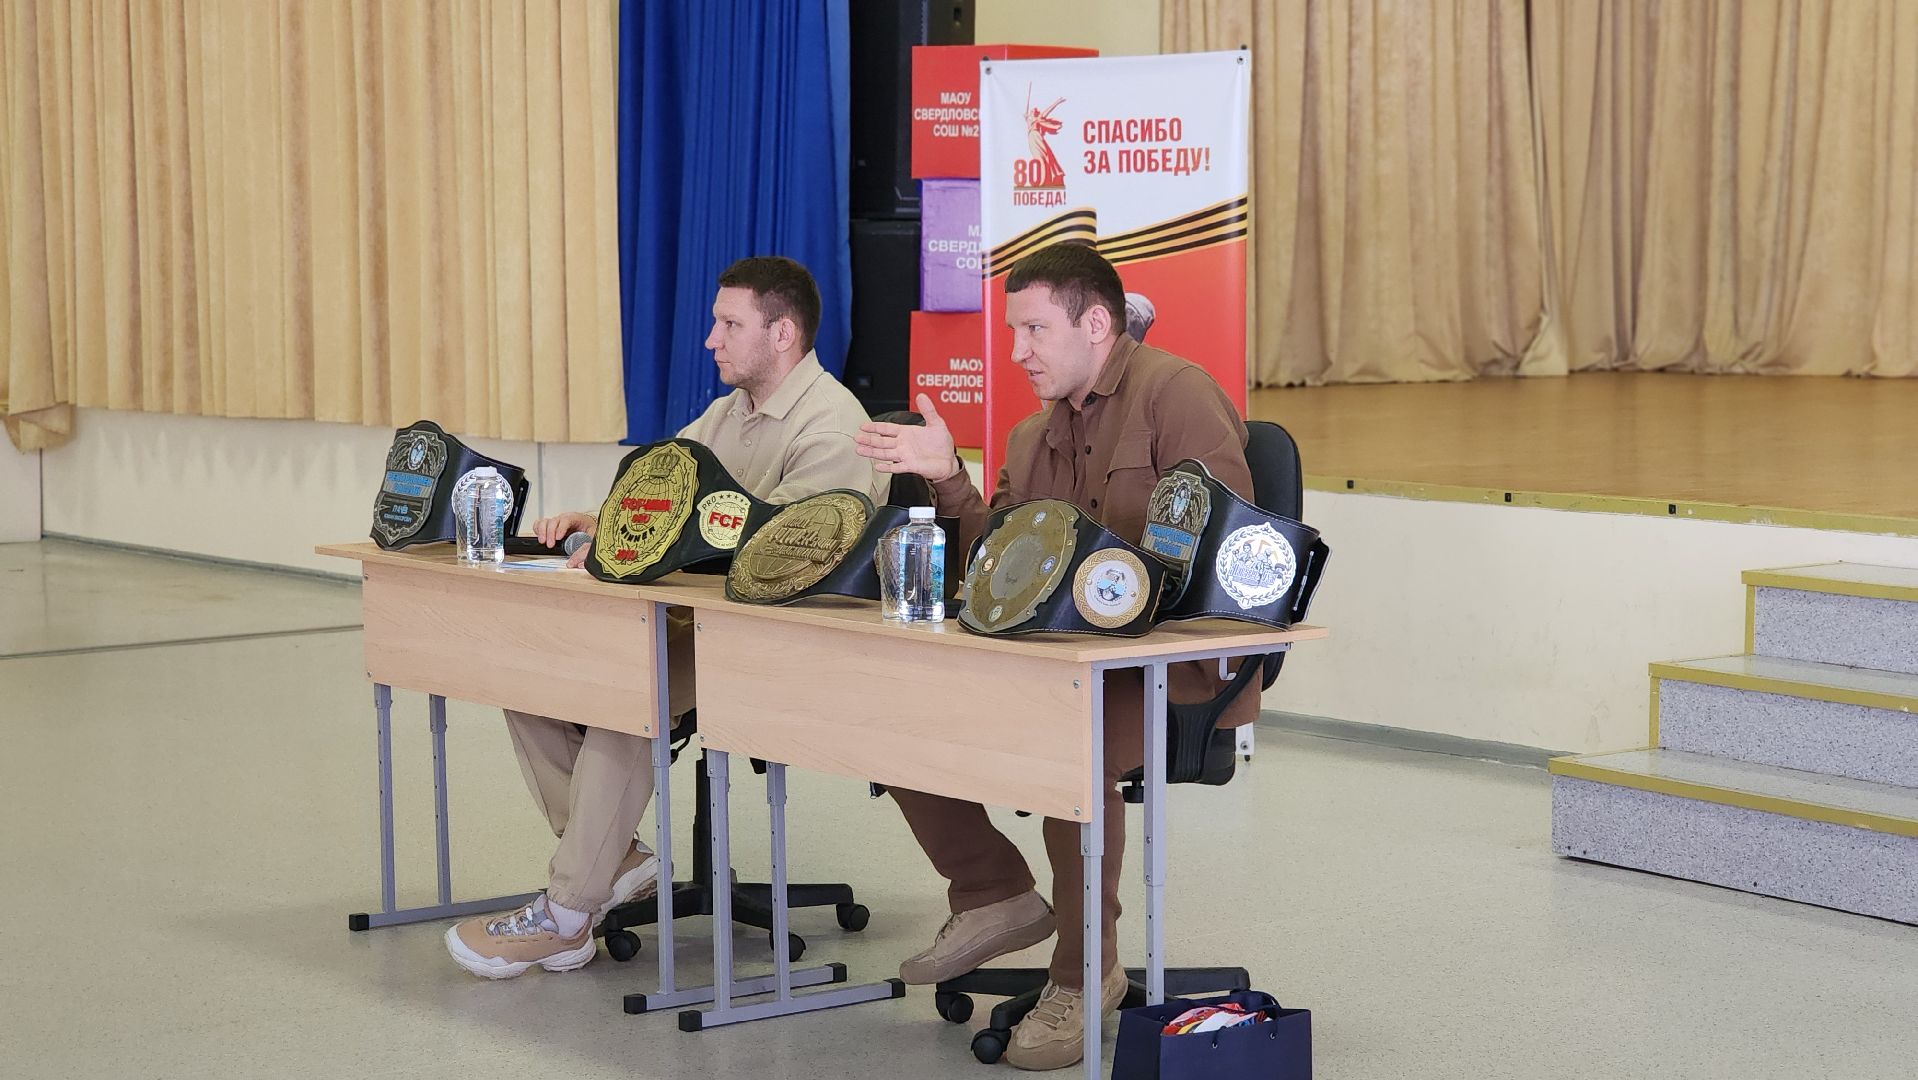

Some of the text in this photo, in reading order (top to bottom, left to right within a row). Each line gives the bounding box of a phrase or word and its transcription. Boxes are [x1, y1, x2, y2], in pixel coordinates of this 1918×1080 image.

[940, 91, 972, 105] МАОУ
[914, 107, 981, 122] СВЕРДЛОВС
[933, 124, 980, 137] СОШ №2
[1083, 117, 1182, 144] СПАСИБО
[1083, 147, 1211, 176] ЗА ПОБЕДУ!
[1013, 158, 1043, 187] 80
[1013, 191, 1067, 207] ПОБЕДА!
[956, 257, 982, 270] СО
[940, 390, 971, 403] СОШ
[701, 495, 717, 511] PRO
[708, 511, 744, 529] FCF
[620, 523, 656, 543] WINNER
